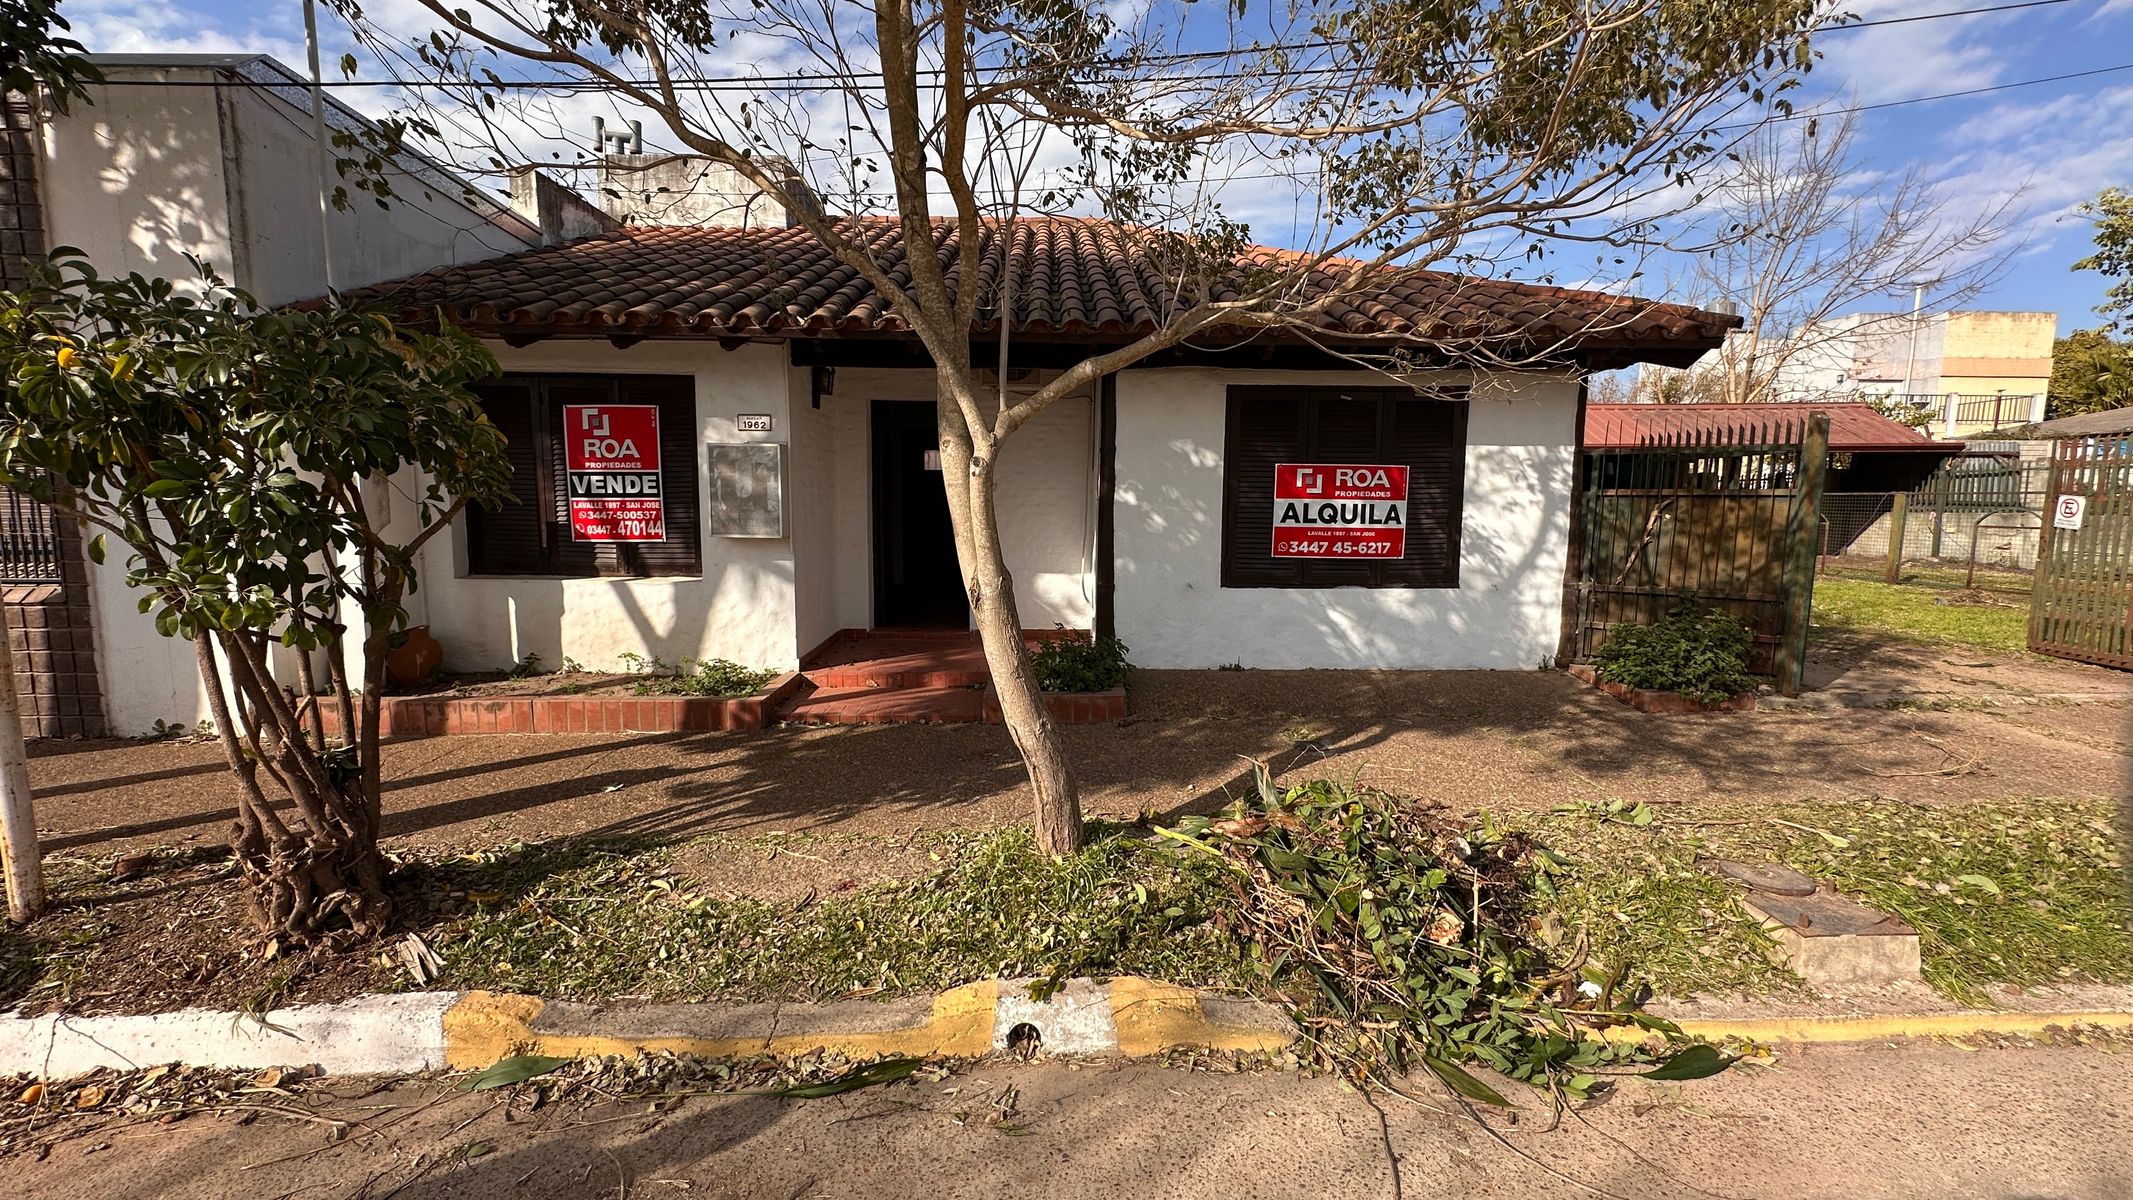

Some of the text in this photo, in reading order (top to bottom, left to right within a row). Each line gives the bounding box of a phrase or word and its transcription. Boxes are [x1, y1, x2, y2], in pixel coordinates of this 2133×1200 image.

[743, 420, 767, 430] 1962
[583, 438, 640, 459] ROA
[584, 461, 642, 469] PROPIEDADES
[571, 475, 658, 494] VENDE
[1335, 469, 1391, 488] ROA
[1335, 490, 1391, 498] PROPIEDADES
[573, 501, 603, 509] LAVALLE
[625, 501, 641, 509] SAN
[642, 501, 661, 509] JOSE
[587, 510, 657, 520] 3447-500537
[1279, 502, 1402, 525] ALQUILA
[586, 524, 612, 535] 03447
[617, 520, 663, 536] 470144
[1289, 541, 1329, 553] 3447
[1332, 541, 1391, 554] 45-6217
